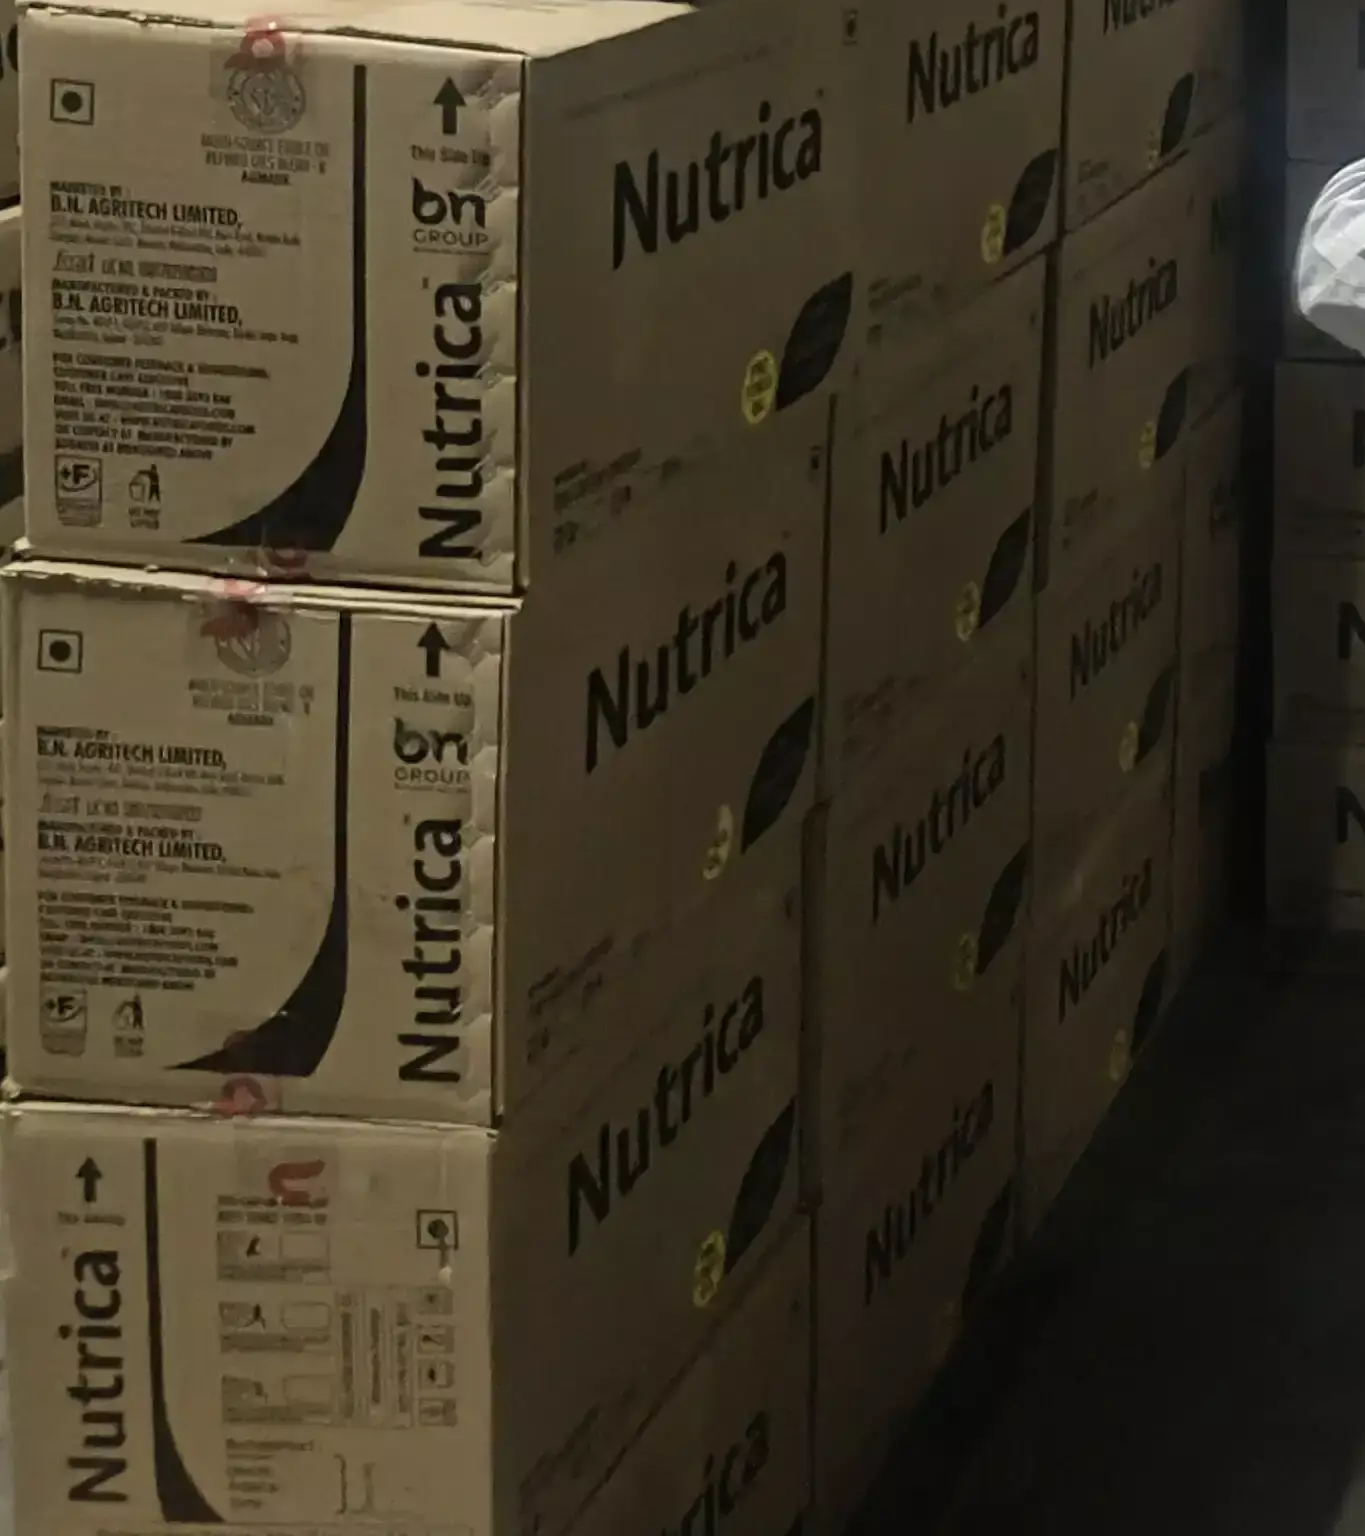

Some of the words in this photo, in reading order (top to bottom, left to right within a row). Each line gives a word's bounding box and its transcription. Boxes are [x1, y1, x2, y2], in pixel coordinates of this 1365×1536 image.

[906, 4, 1039, 124] Nutrica
[87, 198, 168, 221] AGRITECH
[411, 176, 486, 229] bn
[412, 228, 490, 247] GROUP
[611, 101, 824, 269] Nutrica
[89, 296, 169, 319] AGRITECH
[1089, 257, 1179, 371] Nutrica
[415, 282, 484, 560] Nutrica
[878, 377, 1014, 535] Nutrica
[585, 549, 789, 775] Nutrica
[1069, 560, 1163, 701] Nutrica
[393, 717, 469, 765] bn
[872, 732, 1007, 924] Nutrica
[396, 818, 462, 1084] Nutrica
[1058, 857, 1154, 1023] Nutrica
[568, 975, 764, 1257] Nutrica
[864, 1080, 996, 1308] Nutrica
[59, 1249, 128, 1504] Nutrica
